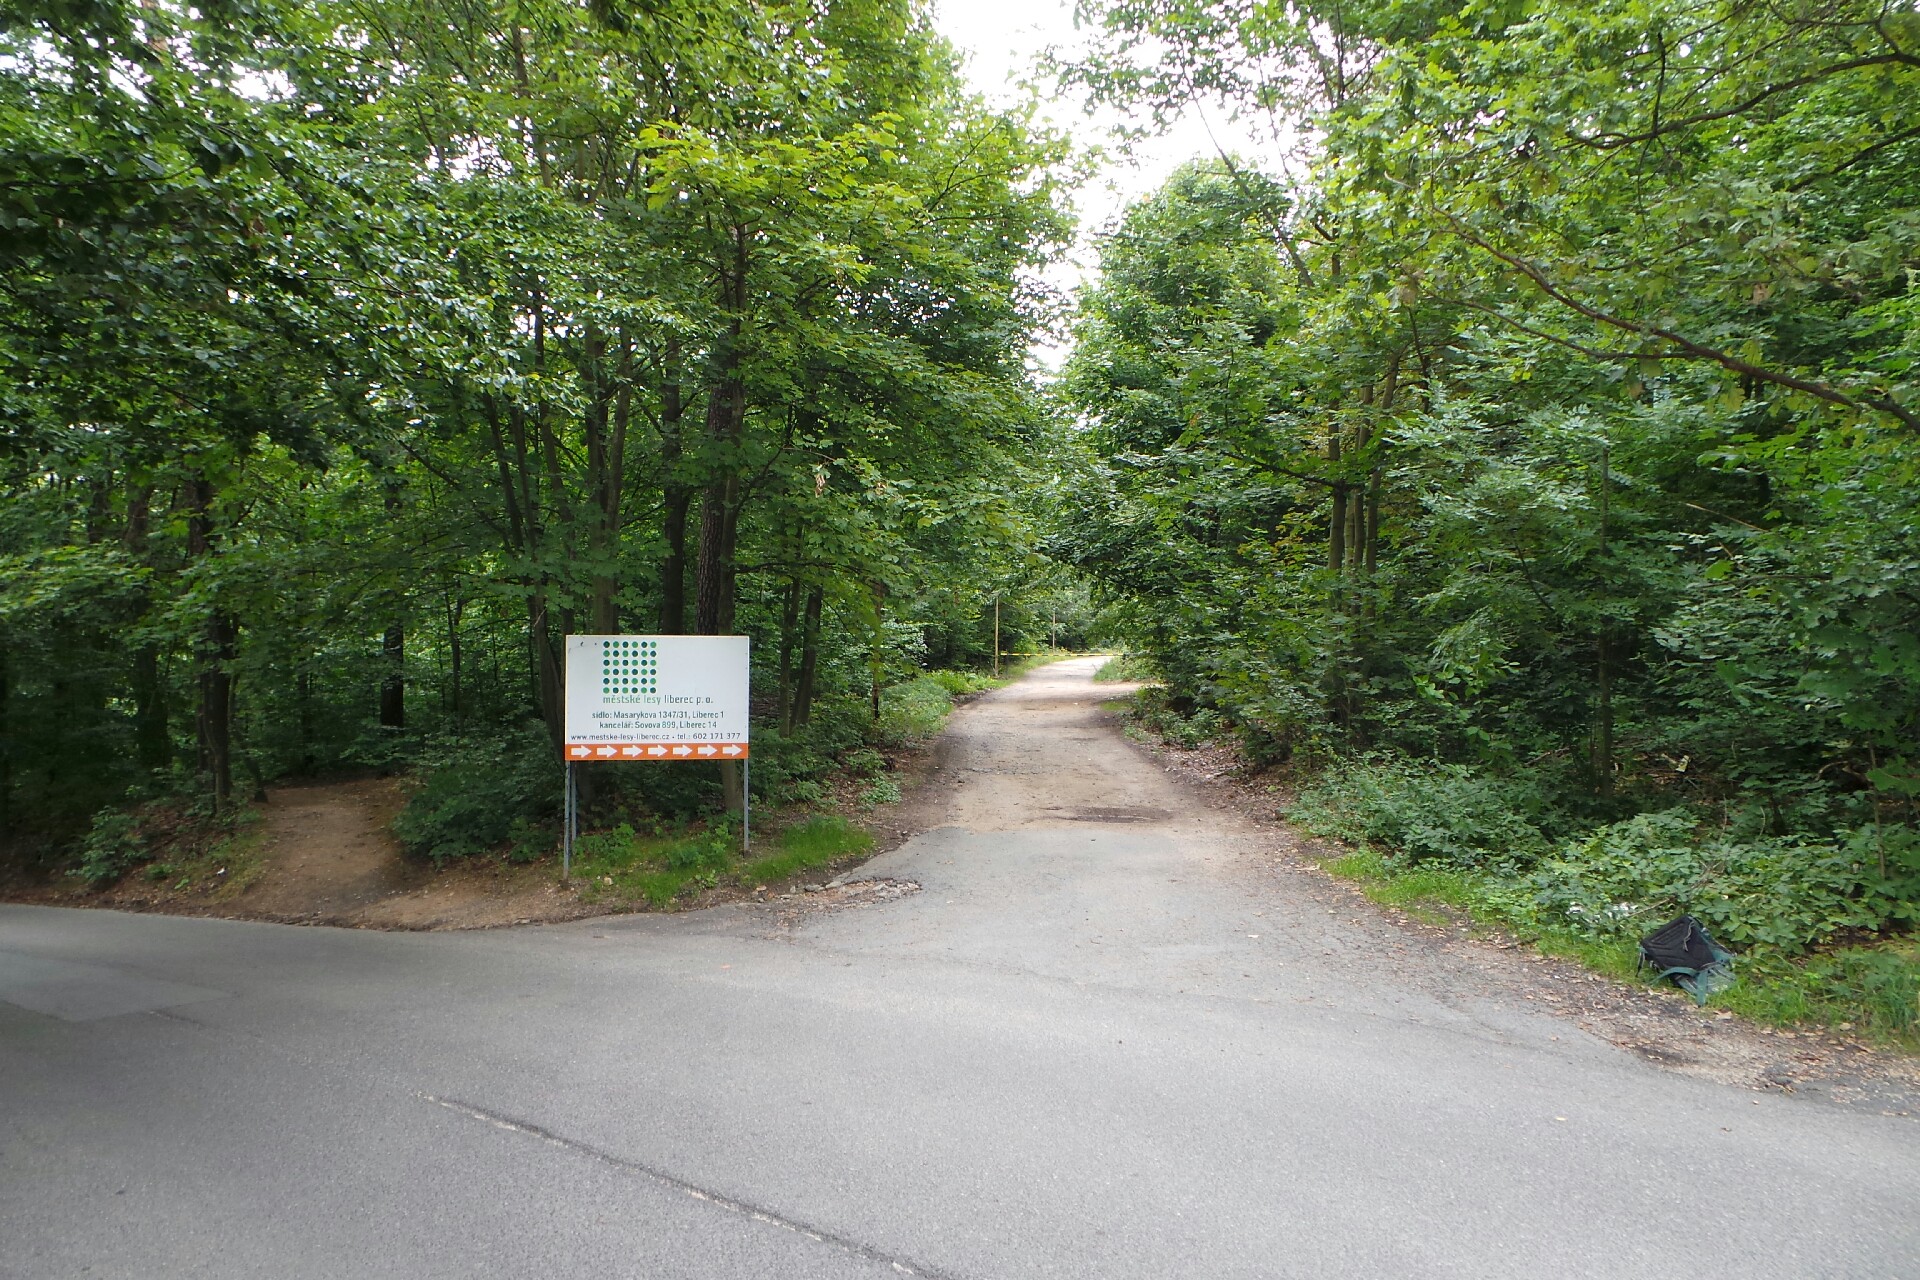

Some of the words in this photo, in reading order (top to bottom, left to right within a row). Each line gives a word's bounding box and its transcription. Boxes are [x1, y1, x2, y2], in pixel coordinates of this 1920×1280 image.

[644, 695, 661, 706] lesy
[664, 694, 694, 704] liberec
[614, 711, 657, 721] Masarykova
[659, 710, 691, 720] 1347/31,
[692, 710, 719, 719] Liberec
[720, 710, 724, 719] 1
[634, 721, 660, 729] Sovova
[662, 720, 679, 730] 899,
[680, 720, 707, 729] Liberec
[708, 721, 718, 729] 14
[571, 733, 670, 741] www.mestske-lesy-liberec.cz
